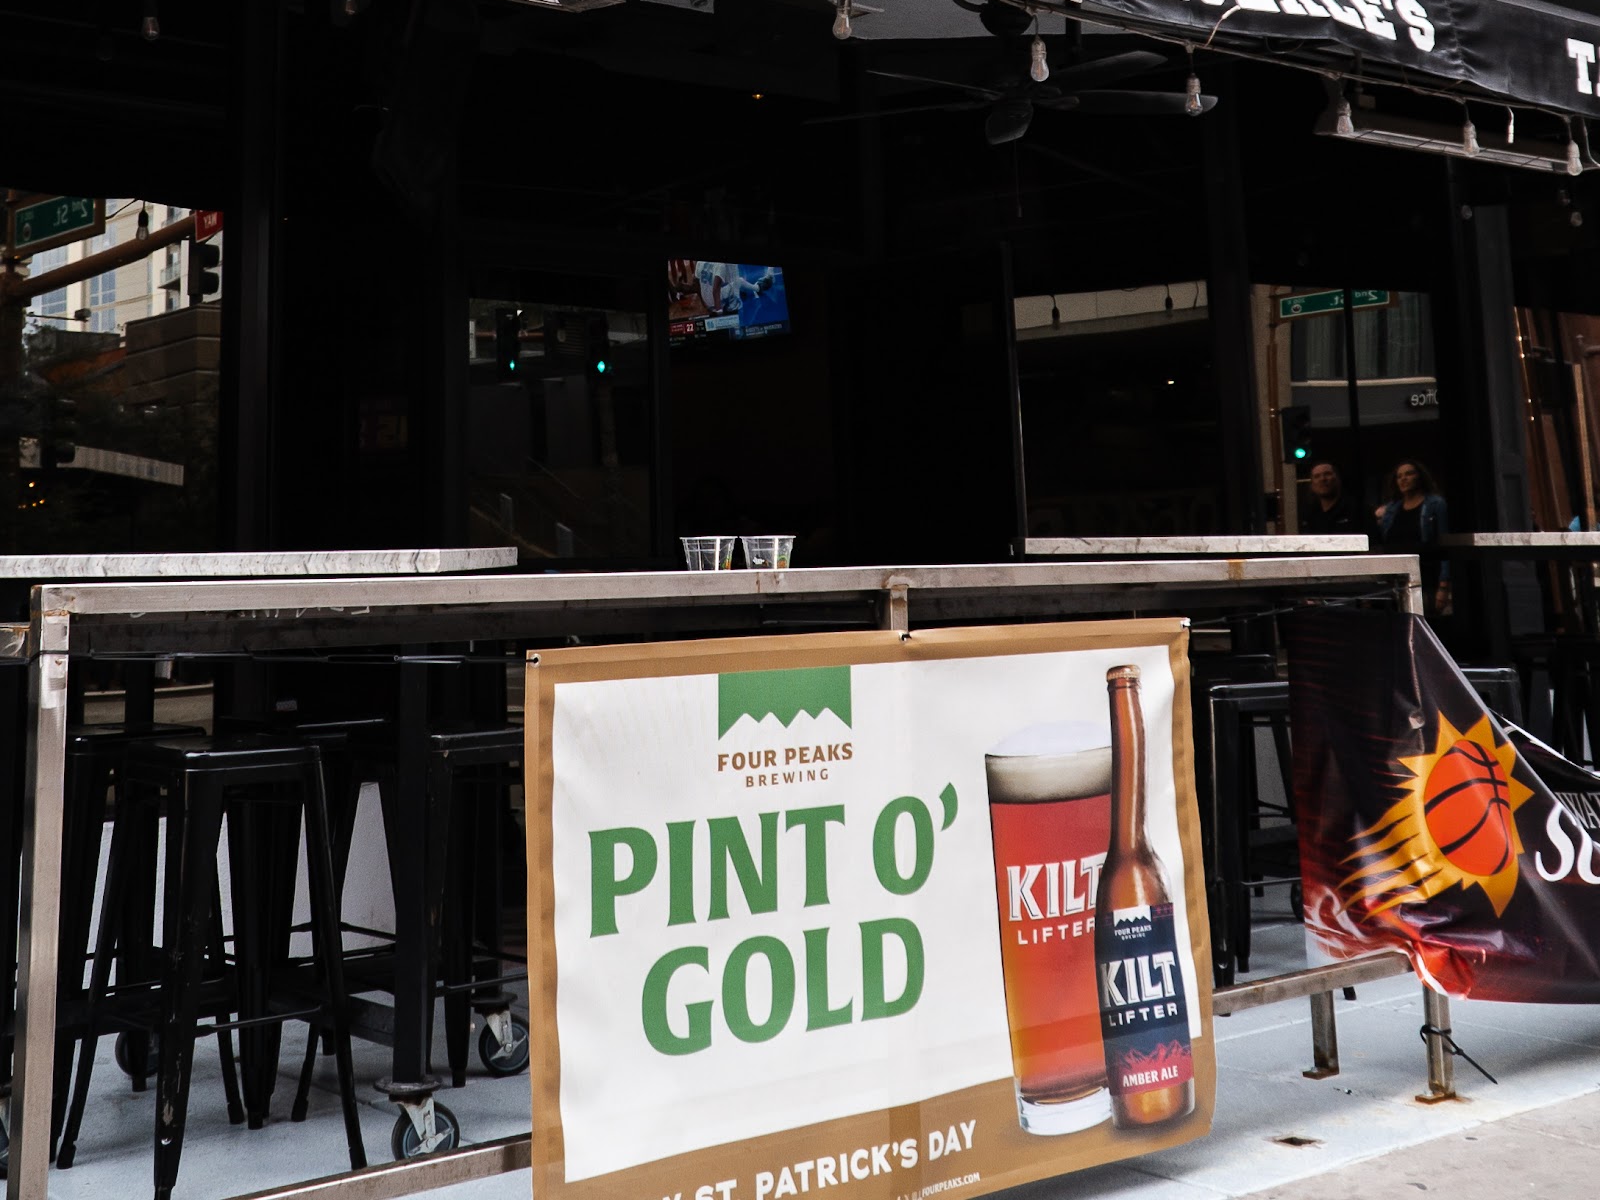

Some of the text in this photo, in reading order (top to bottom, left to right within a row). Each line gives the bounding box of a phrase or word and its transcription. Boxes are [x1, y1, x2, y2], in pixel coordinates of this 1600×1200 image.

[717, 742, 853, 772] FOUR PEAKS
[745, 768, 829, 788] BREWING
[588, 782, 959, 939] PINT O'
[1006, 851, 1108, 922] KILT
[641, 917, 925, 1056] GOLD
[1100, 950, 1176, 1008] KILT
[1108, 1002, 1178, 1027] LIFTER
[1122, 1065, 1179, 1088] AMBER ALE
[755, 1138, 918, 1200] PATRICK'S
[928, 1119, 977, 1162] DAY
[922, 1171, 981, 1198] FOURPEAKS.COM
